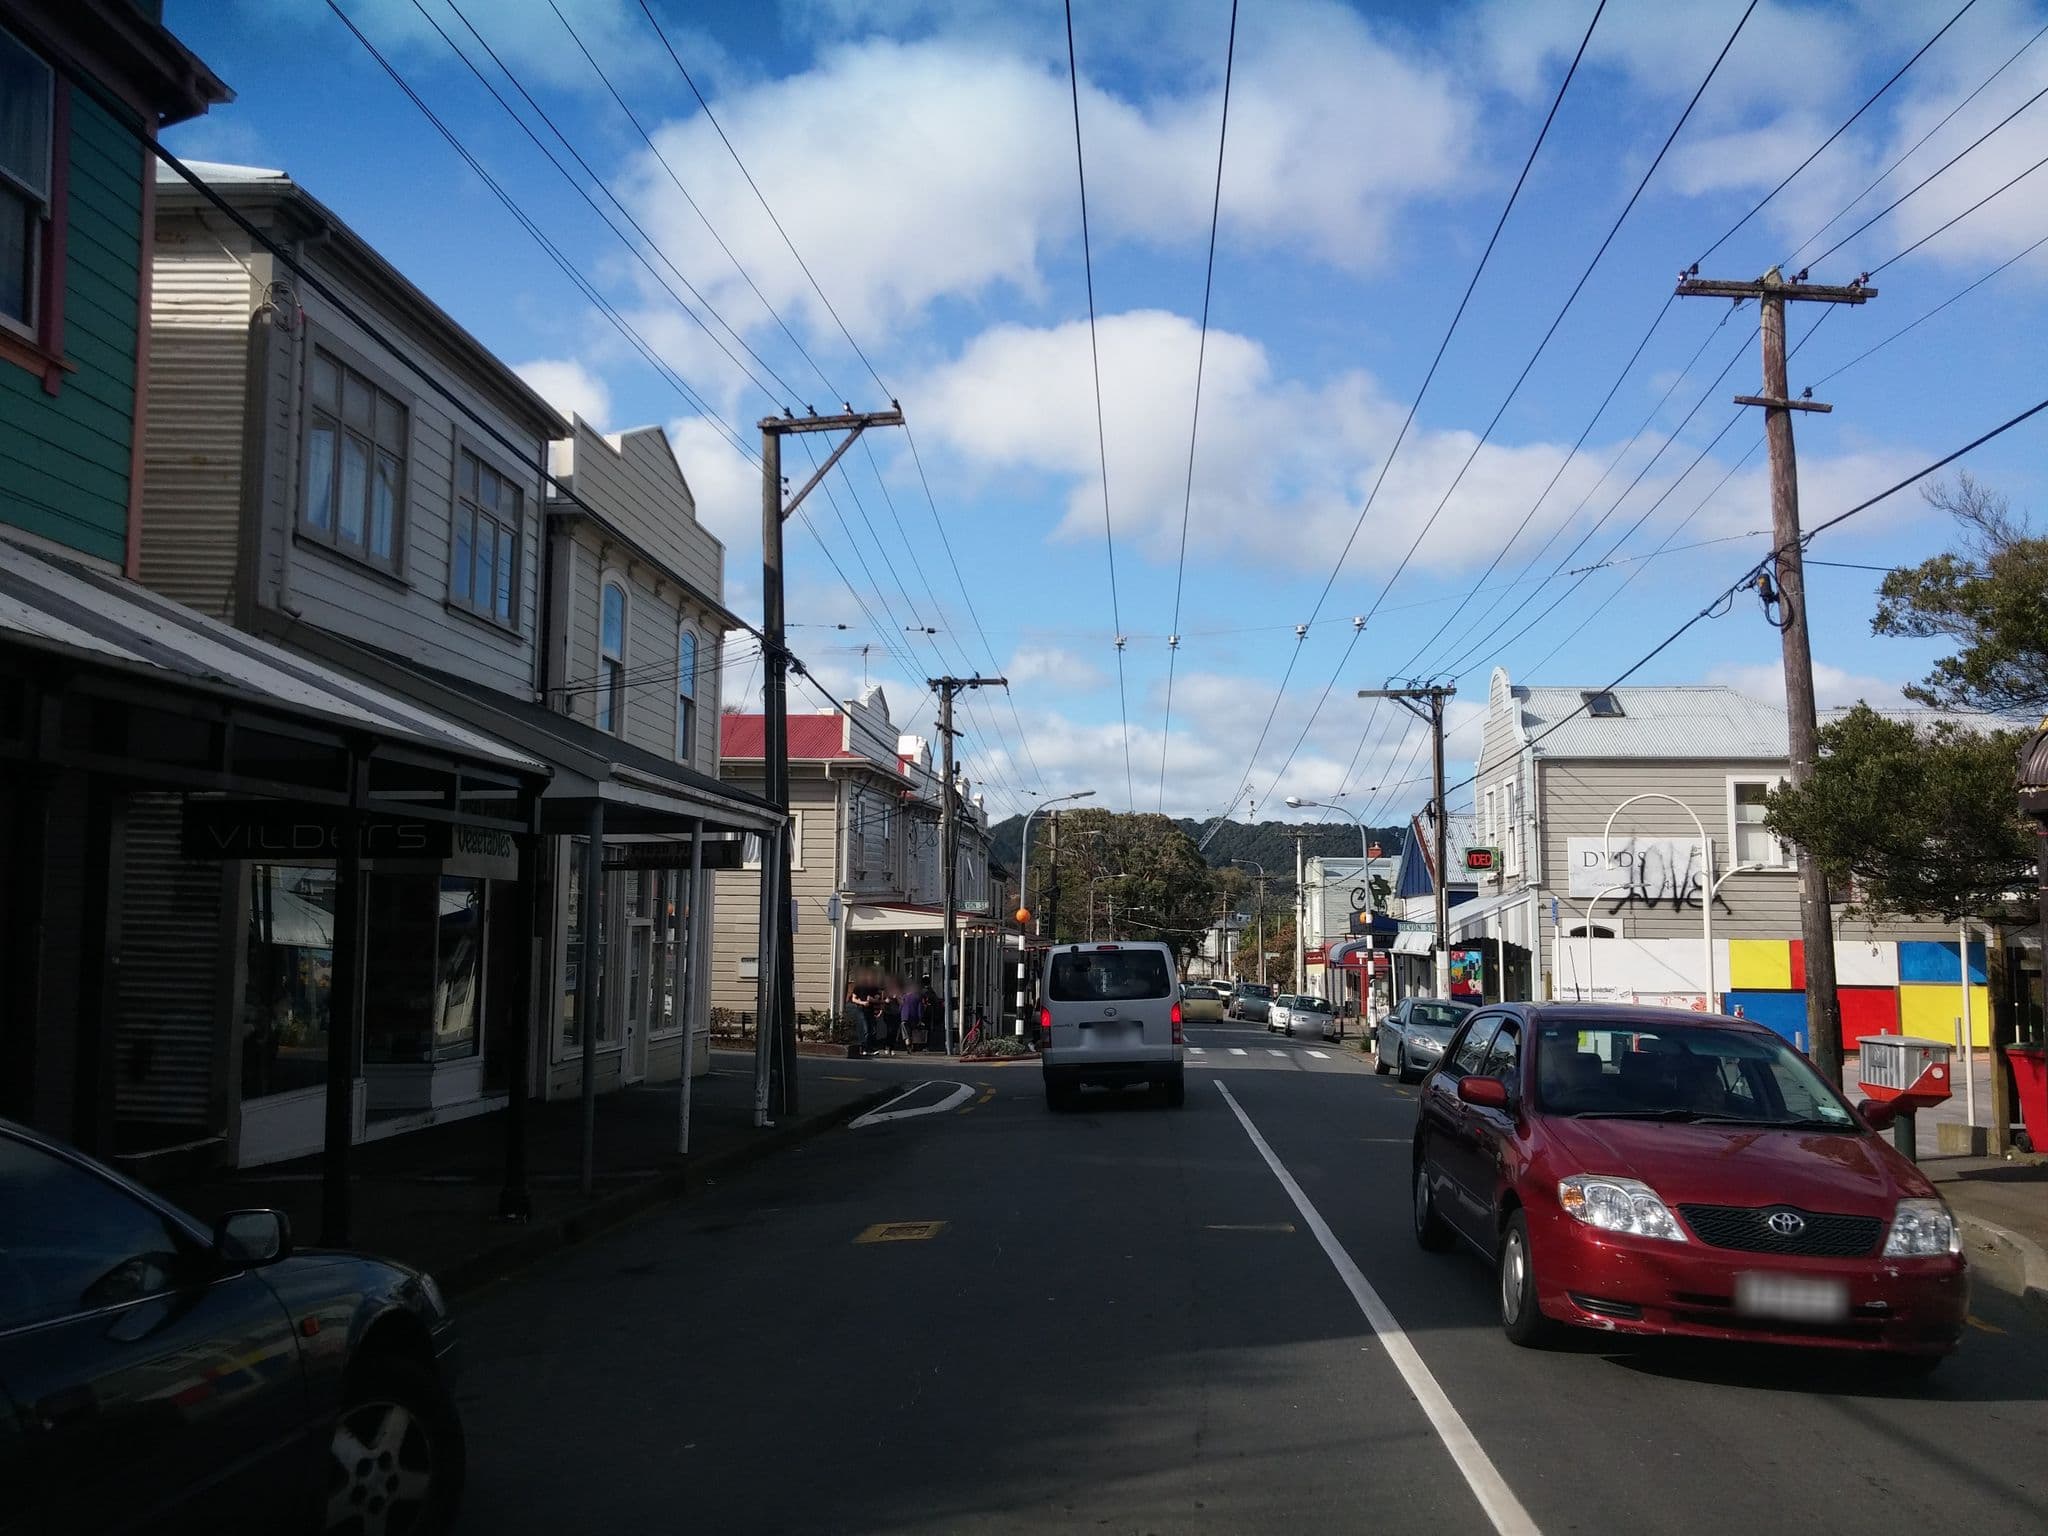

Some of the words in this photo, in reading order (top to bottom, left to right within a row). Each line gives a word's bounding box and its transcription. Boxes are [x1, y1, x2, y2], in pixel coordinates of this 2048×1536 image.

[1467, 853, 1493, 866] VIDEO
[1400, 924, 1422, 932] DEVON
[1425, 923, 1434, 932] ST
